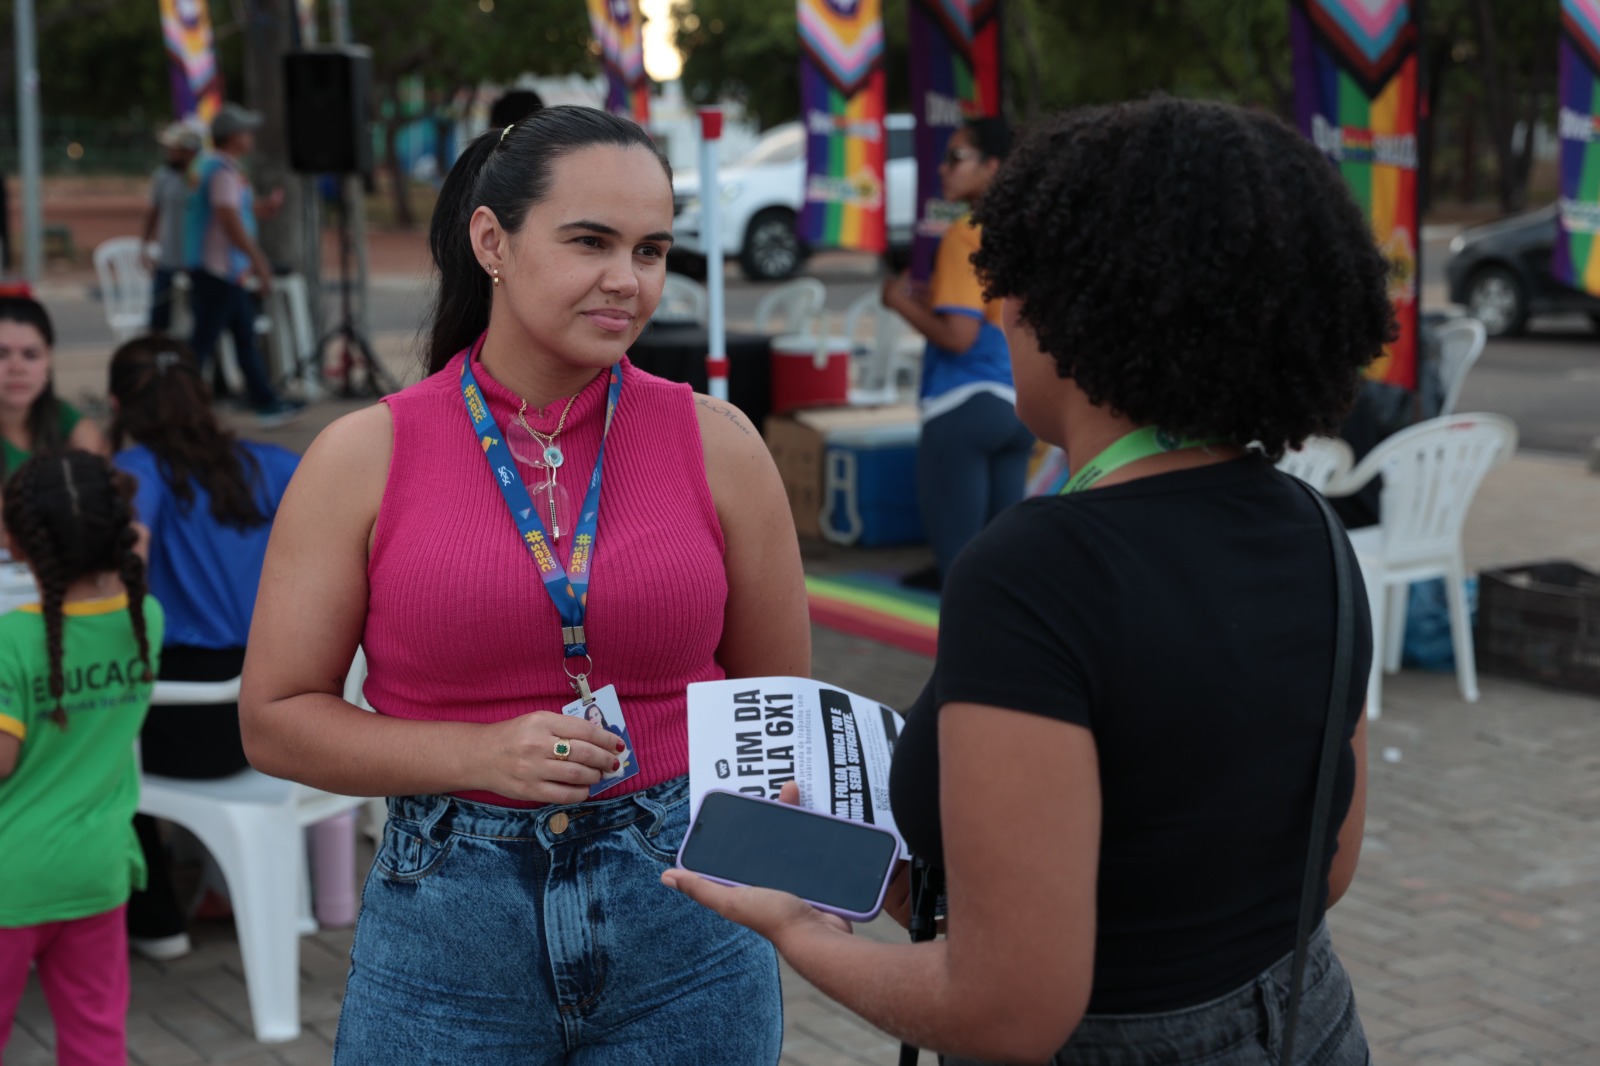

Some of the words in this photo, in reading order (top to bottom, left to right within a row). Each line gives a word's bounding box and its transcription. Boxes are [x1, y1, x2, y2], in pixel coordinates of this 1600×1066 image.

[733, 689, 761, 722] DA
[764, 693, 794, 736] 6X1
[830, 707, 842, 715] E
[831, 715, 845, 731] FOI
[736, 731, 765, 777] FIM
[832, 733, 847, 765] NUNCA
[834, 767, 849, 799] FOLGA
[846, 766, 863, 790] SERÁ
[835, 801, 850, 818] MA
[850, 793, 865, 821] UNCA
